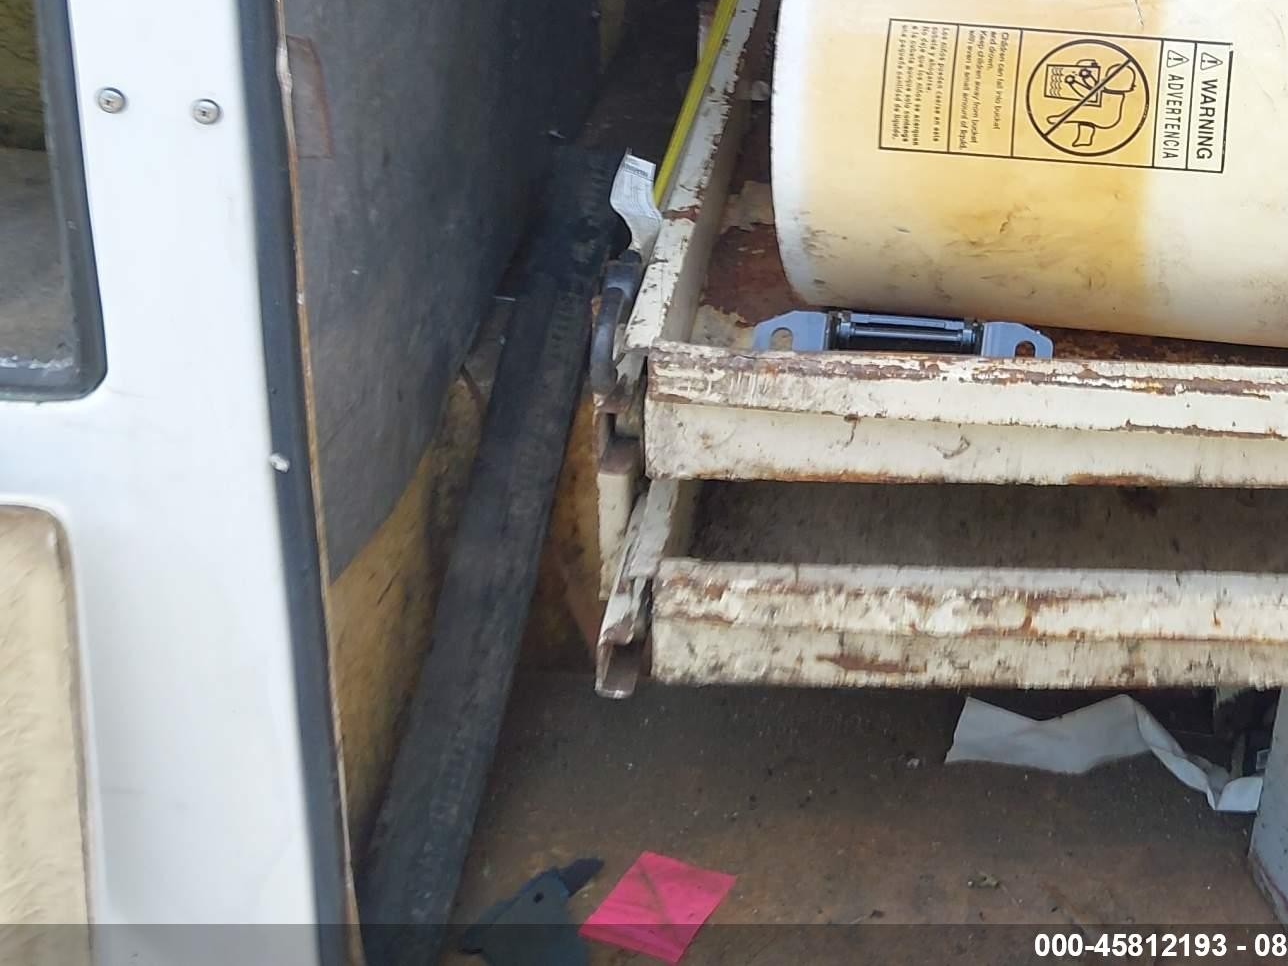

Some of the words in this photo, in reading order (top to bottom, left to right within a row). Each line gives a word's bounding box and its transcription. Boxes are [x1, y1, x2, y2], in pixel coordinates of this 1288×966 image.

[921, 26, 930, 35] No
[929, 26, 938, 50] cubeta
[941, 27, 949, 40] Los
[967, 30, 975, 44] with
[977, 30, 987, 49] Keep
[999, 32, 1009, 62] Children
[917, 55, 926, 68] que
[975, 50, 984, 79] children
[996, 63, 1004, 77] can
[936, 63, 944, 89] pueden
[962, 71, 970, 90] small
[996, 78, 1004, 89] fall
[971, 81, 980, 100] away
[994, 90, 1002, 104] into
[960, 92, 968, 119] amount
[972, 101, 981, 117] from
[934, 116, 941, 125] en
[960, 120, 968, 128] of
[992, 105, 1002, 129] bucket
[1162, 74, 1184, 159] ADVERTENCIA
[1196, 79, 1218, 159] WARNING
[911, 114, 920, 145] acerquen
[970, 119, 980, 143] bucket
